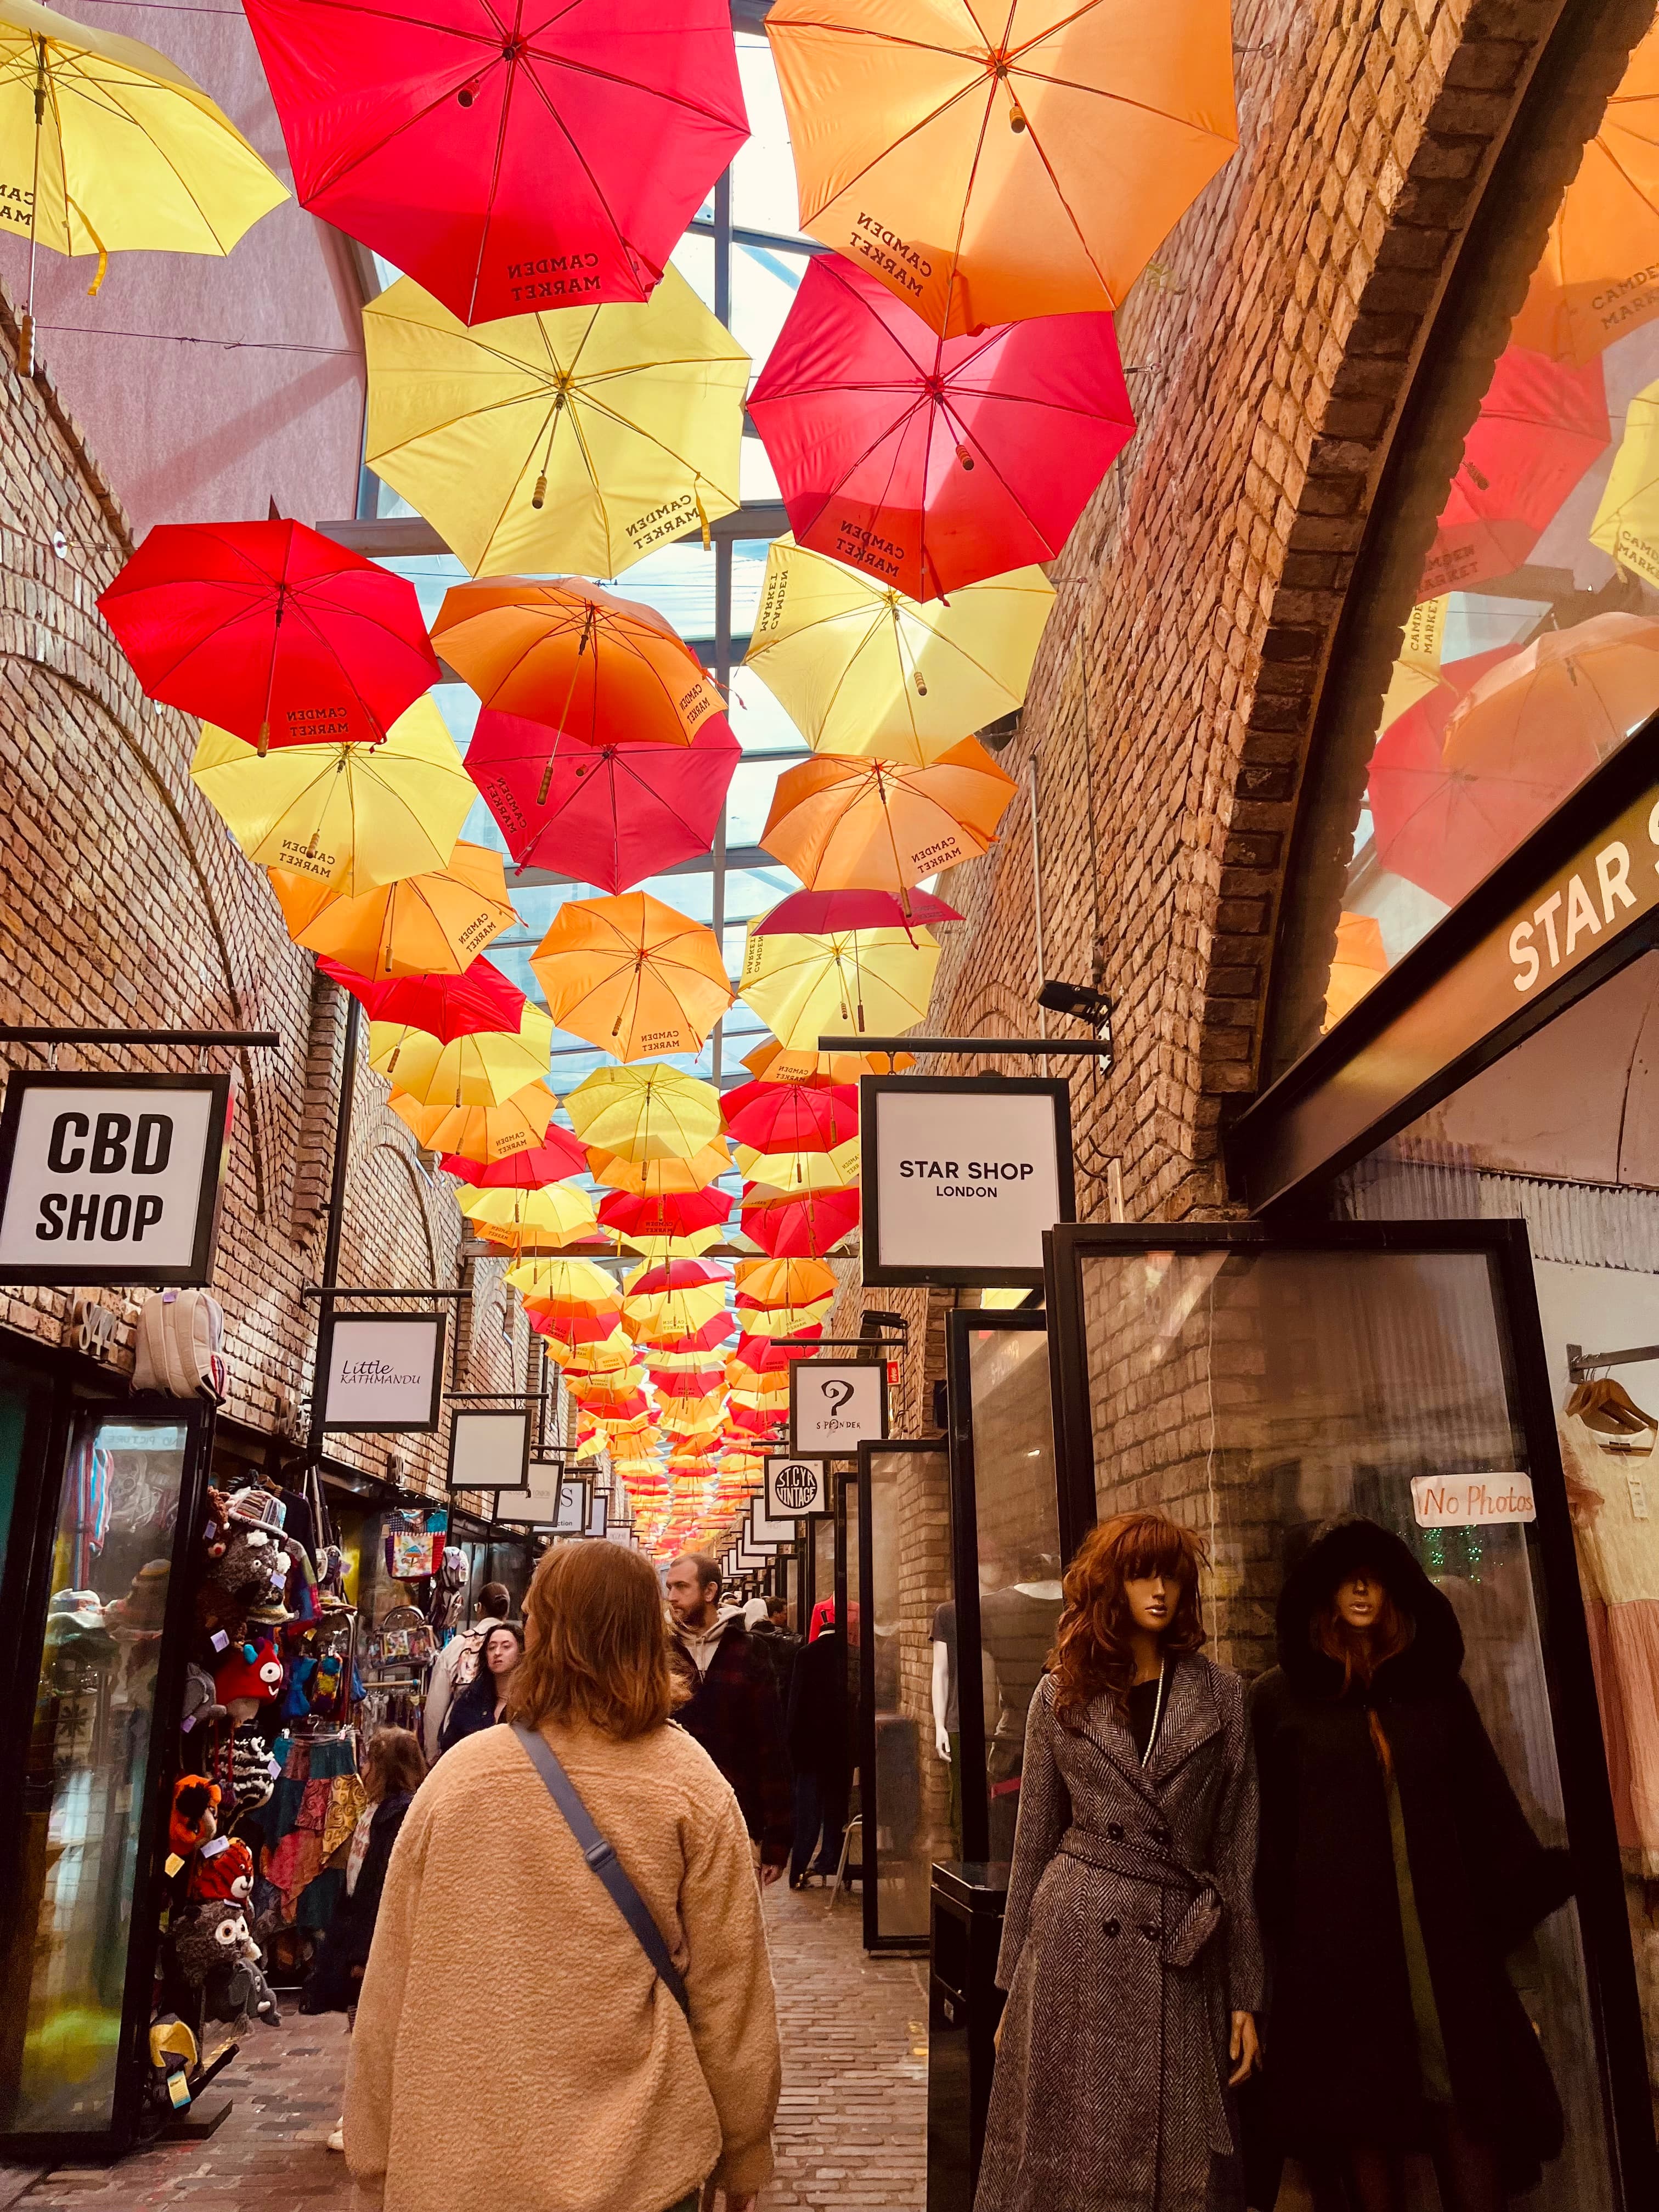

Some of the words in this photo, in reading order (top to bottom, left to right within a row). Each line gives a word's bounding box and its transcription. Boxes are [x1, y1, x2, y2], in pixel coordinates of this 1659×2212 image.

[1622, 531, 1659, 564] CAMD
[1410, 605, 1423, 651] CAMDE
[1509, 841, 1637, 992] STAR
[47, 1111, 174, 1175] CBD
[900, 1160, 959, 1178] STAR
[968, 1162, 1034, 1180] SHOP
[936, 1186, 997, 1198] LONDON
[36, 1193, 165, 1242] SHOP
[340, 1374, 421, 1384] KATHMANDU
[343, 1360, 394, 1375] Little
[776, 1486, 816, 1508] VINTAGE
[1424, 1487, 1459, 1515] No
[1466, 1485, 1533, 1516] Photos
